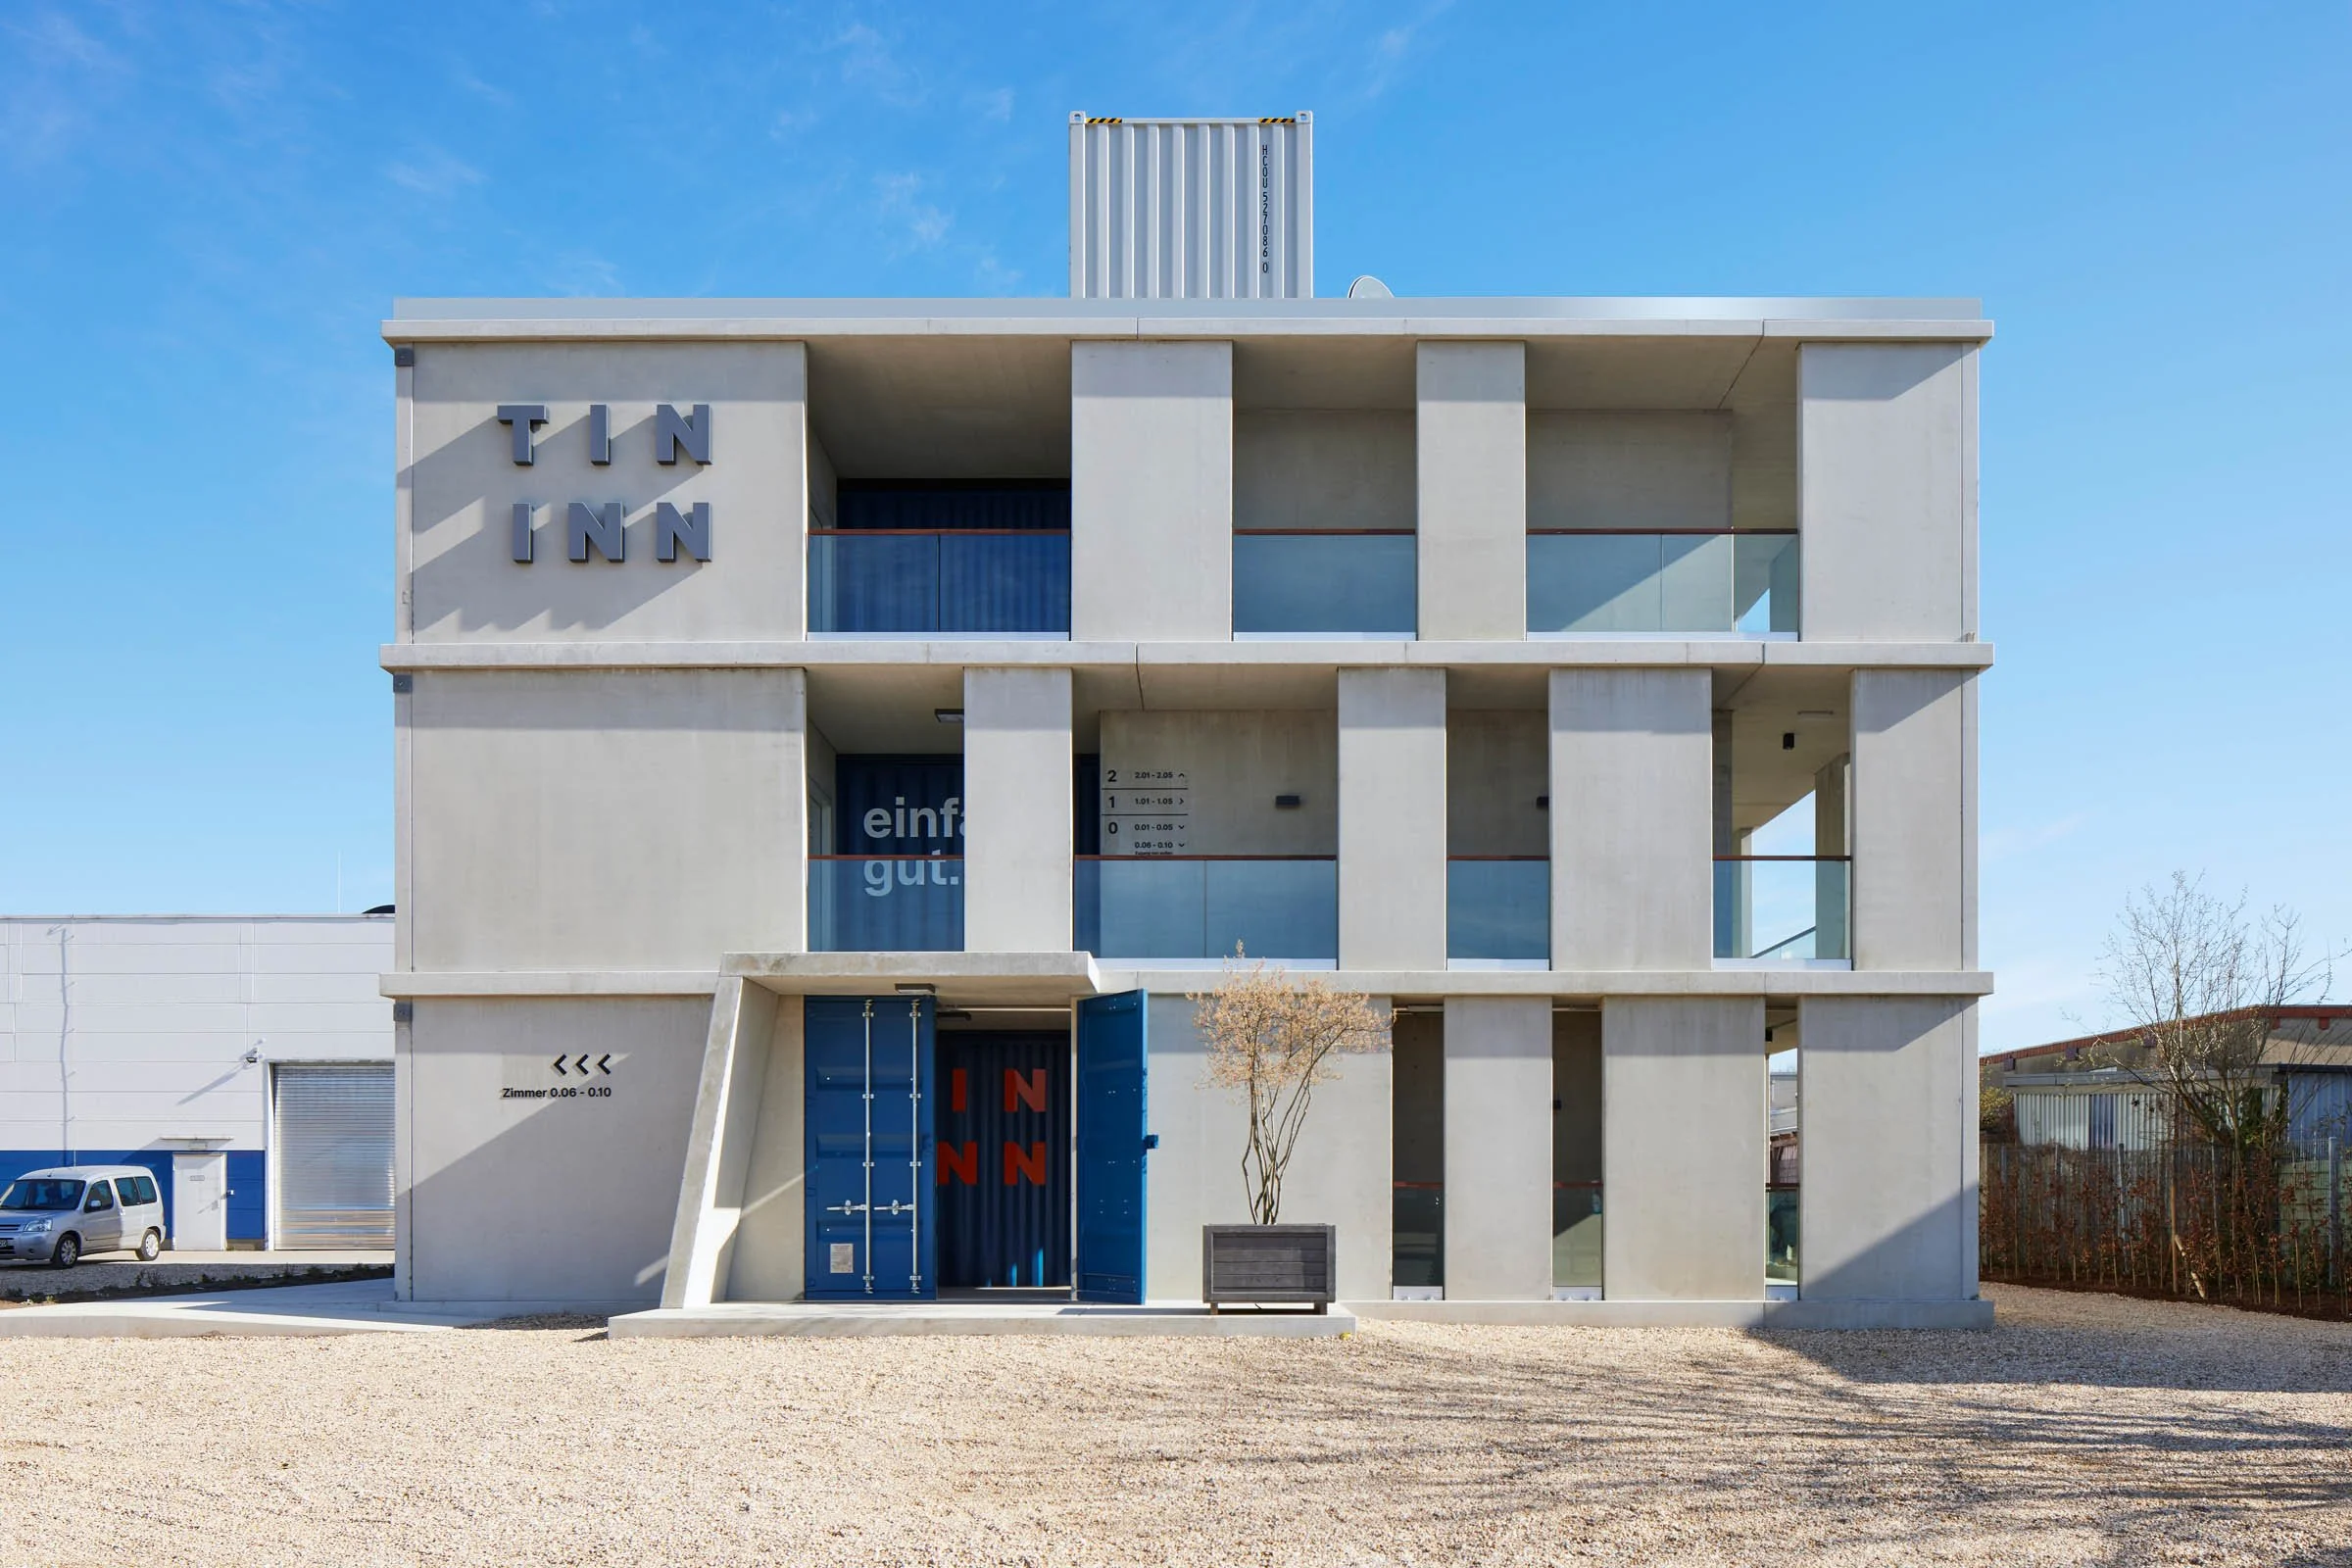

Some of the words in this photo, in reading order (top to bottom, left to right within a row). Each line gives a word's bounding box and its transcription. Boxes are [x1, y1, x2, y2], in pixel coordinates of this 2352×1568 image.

[1262, 262, 1269, 273] 0
[497, 404, 712, 466] TIN
[513, 502, 712, 564] INN
[1107, 769, 1117, 782] 2
[1108, 796, 1115, 808] 1
[863, 796, 965, 838] einf
[1108, 822, 1118, 834] 0
[863, 850, 959, 897] gut.
[503, 1087, 547, 1098] Zimmer
[550, 1087, 576, 1098] 0.06
[588, 1087, 612, 1098] 0.10
